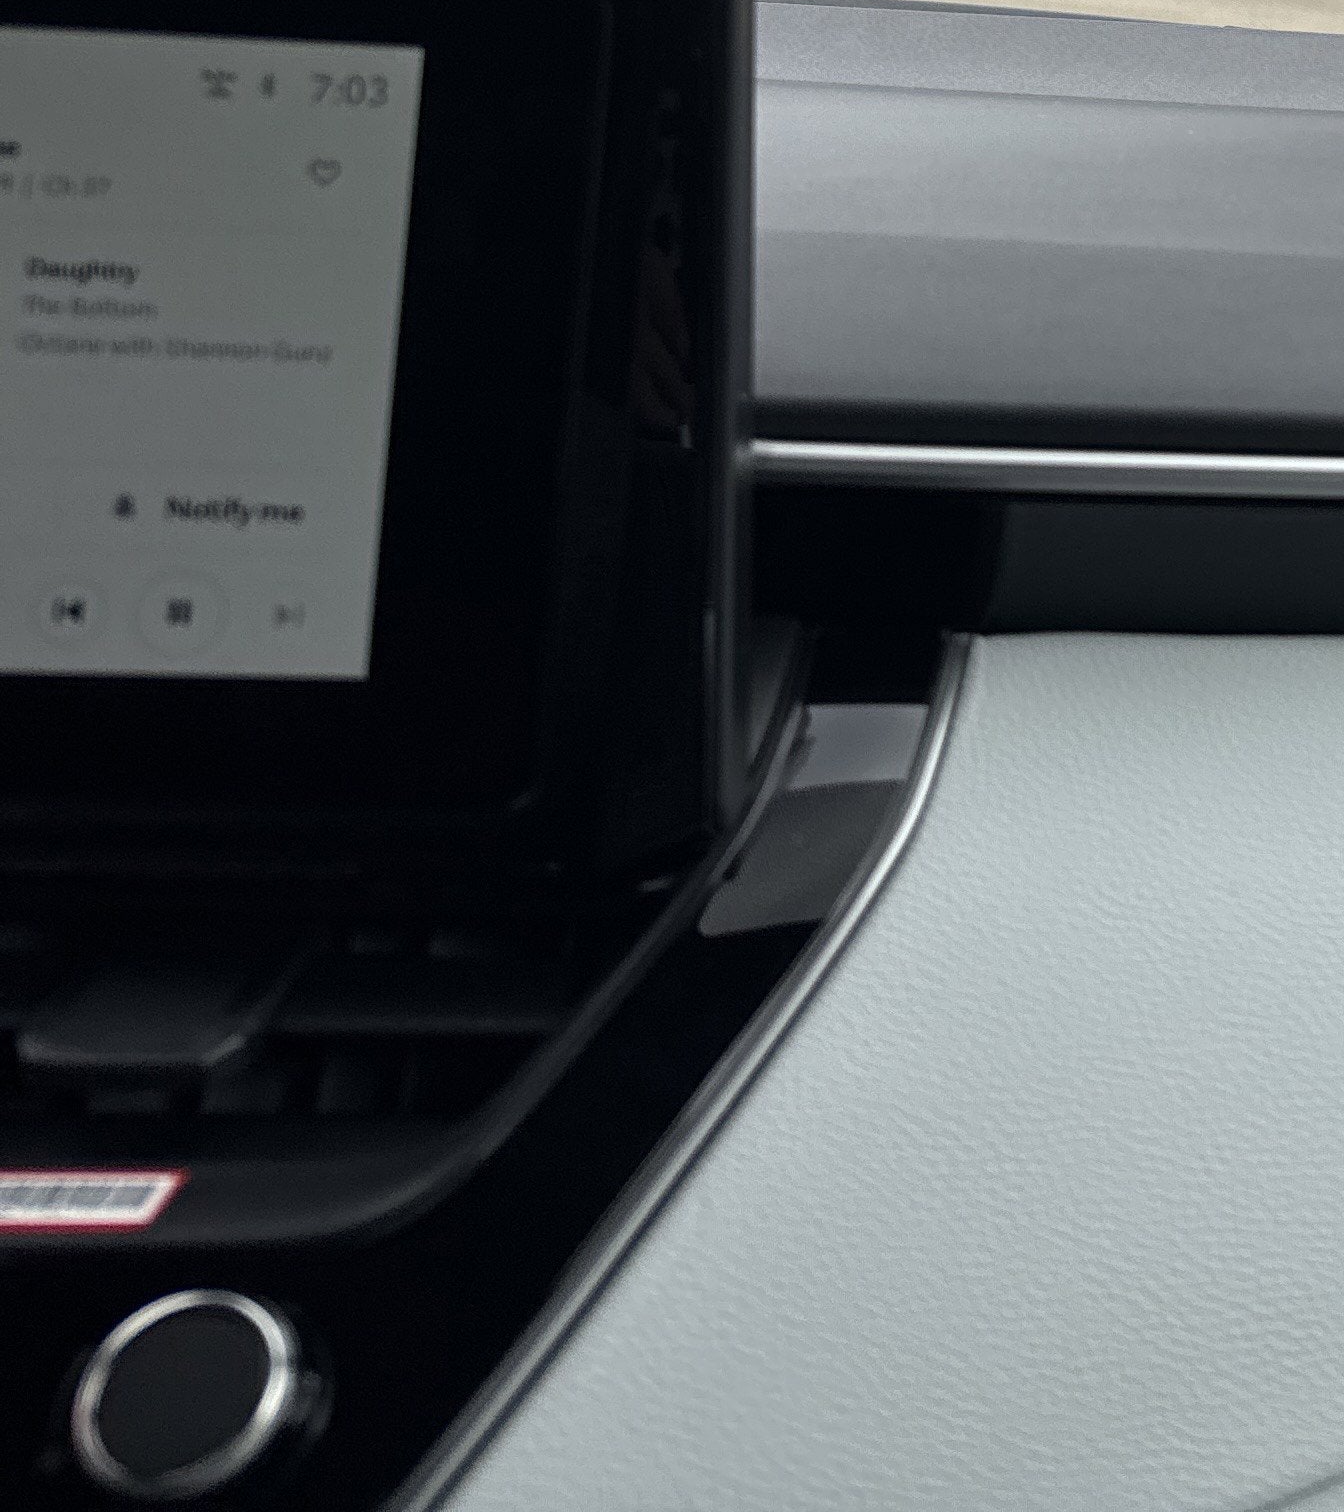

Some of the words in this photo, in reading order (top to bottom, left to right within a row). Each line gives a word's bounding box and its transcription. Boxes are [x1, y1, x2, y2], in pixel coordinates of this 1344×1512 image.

[310, 71, 389, 108] 7:03
[165, 496, 250, 531] Notify
[256, 502, 305, 526] me
